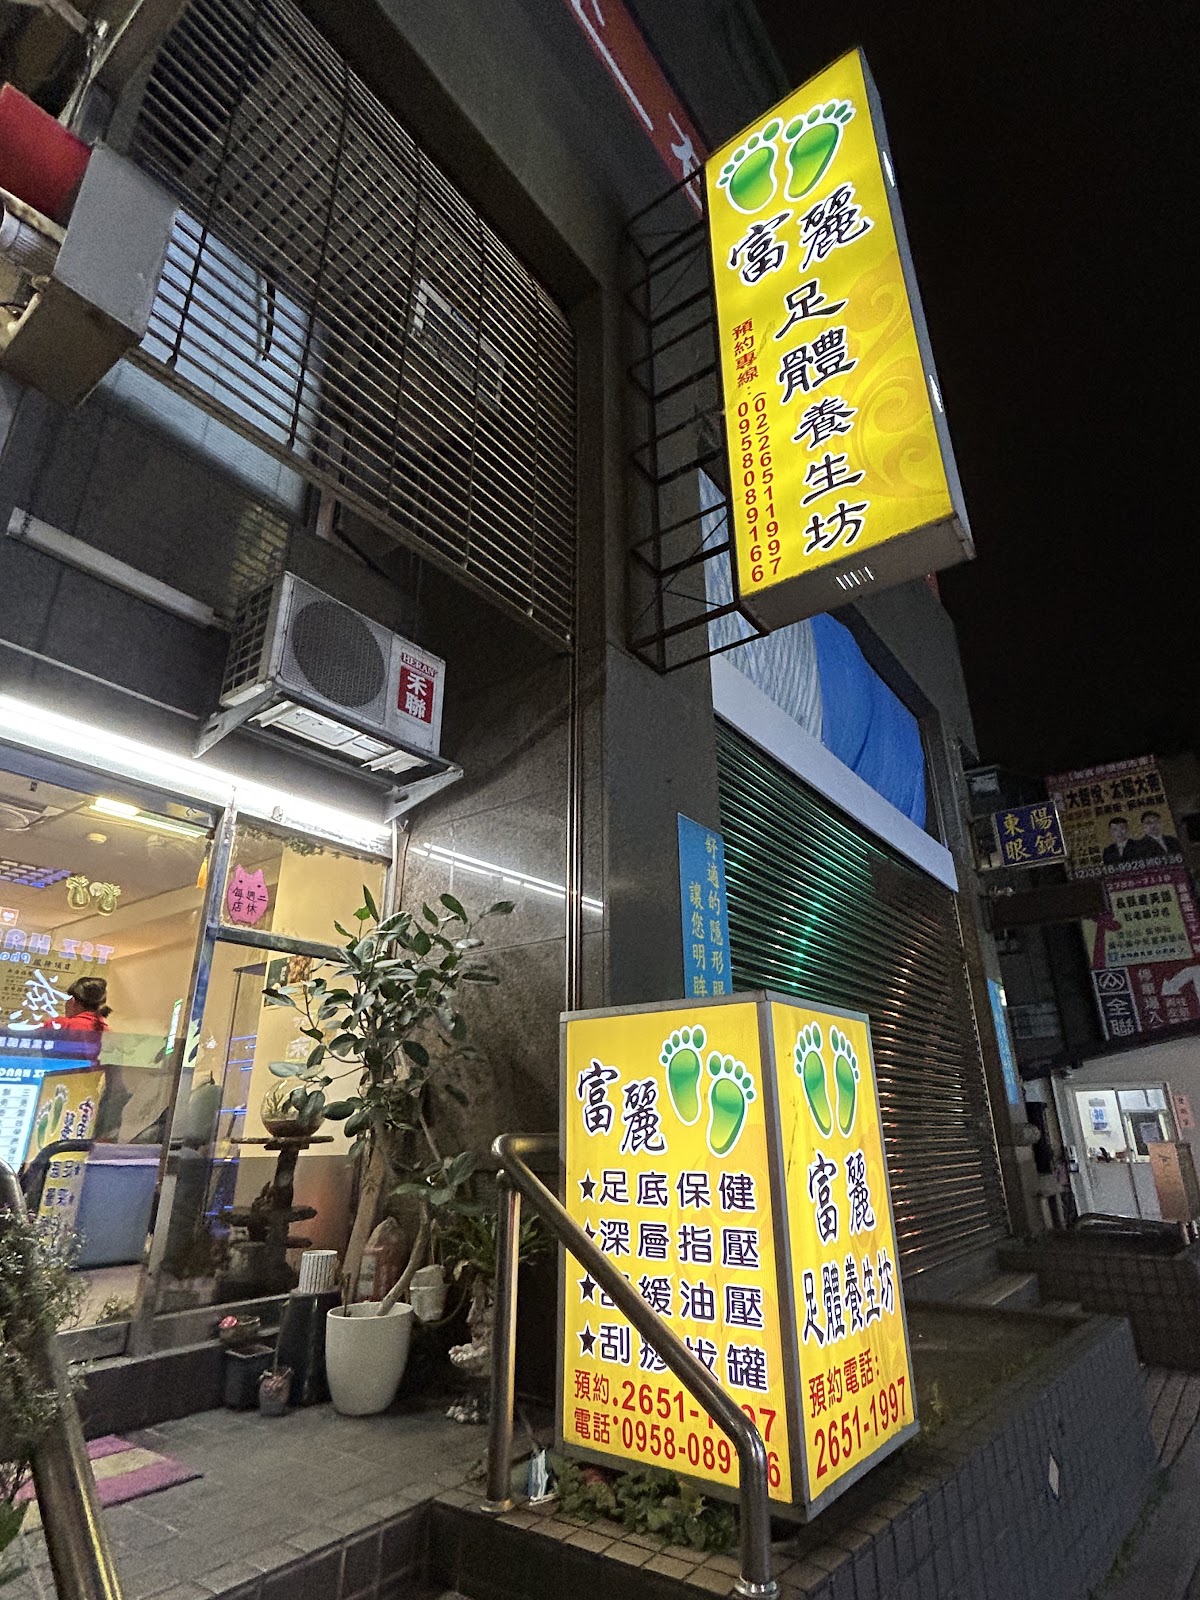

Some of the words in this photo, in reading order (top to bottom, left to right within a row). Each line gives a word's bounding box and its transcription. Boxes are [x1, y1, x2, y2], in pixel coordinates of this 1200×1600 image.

[730, 186, 871, 283] 富麗
[775, 280, 868, 553] 足體養生坊
[737, 402, 764, 582] 0958089166
[406, 672, 428, 718] 禾聯
[1003, 808, 1053, 836] 東陽
[1006, 833, 1063, 862] 眼鏡
[231, 886, 267, 903] 每週二
[231, 902, 258, 916] 店休
[1106, 997, 1136, 1038] 全聯
[577, 1060, 665, 1152] 富麗
[599, 1170, 756, 1211] 足底保健
[809, 1152, 875, 1243] 富麗
[599, 1219, 760, 1268] 深層指壓
[802, 1250, 895, 1345] 足體養生坊
[621, 1380, 776, 1443] 2651-7
[814, 1376, 906, 1480] 2651-1997
[621, 1417, 781, 1488] 0958-0896
